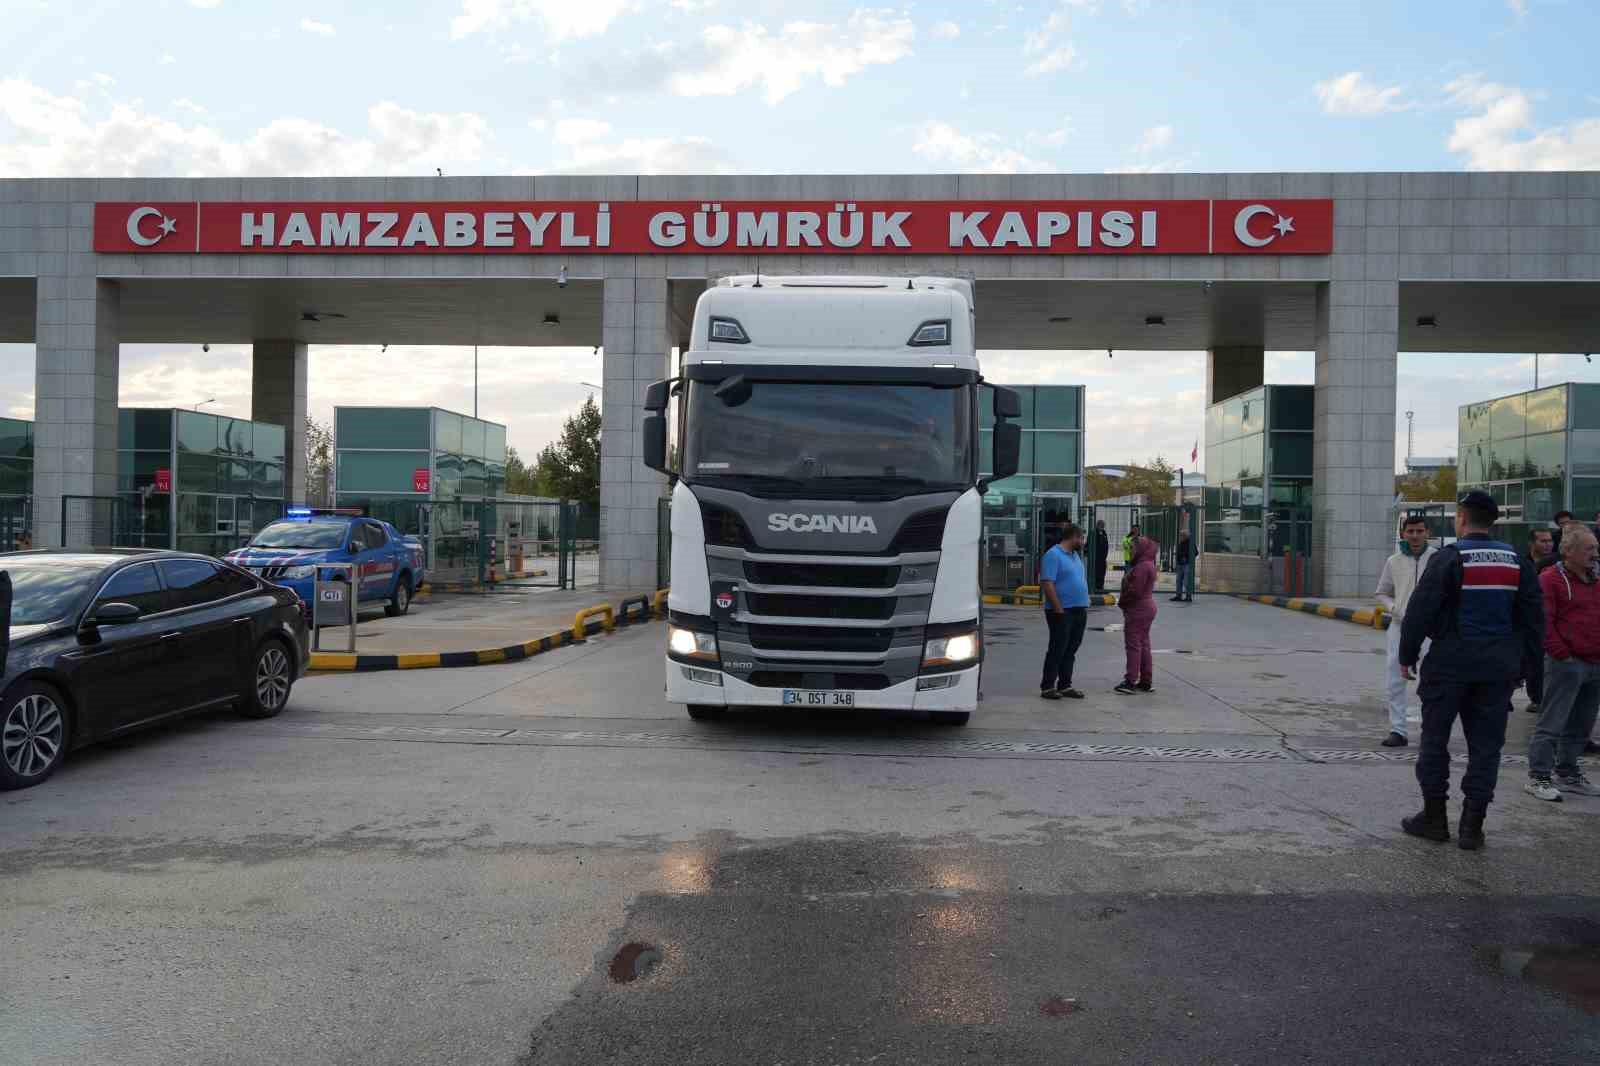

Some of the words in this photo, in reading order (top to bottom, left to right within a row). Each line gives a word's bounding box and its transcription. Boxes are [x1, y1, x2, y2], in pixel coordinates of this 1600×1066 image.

[239, 203, 612, 248] HAMZABEYLİ
[648, 203, 913, 248] GÜMRÜK
[948, 210, 1158, 248] KAPISI
[767, 512, 878, 534] SCANIA
[790, 692, 802, 704] 34
[808, 692, 827, 704] DST
[832, 693, 852, 705] 348
